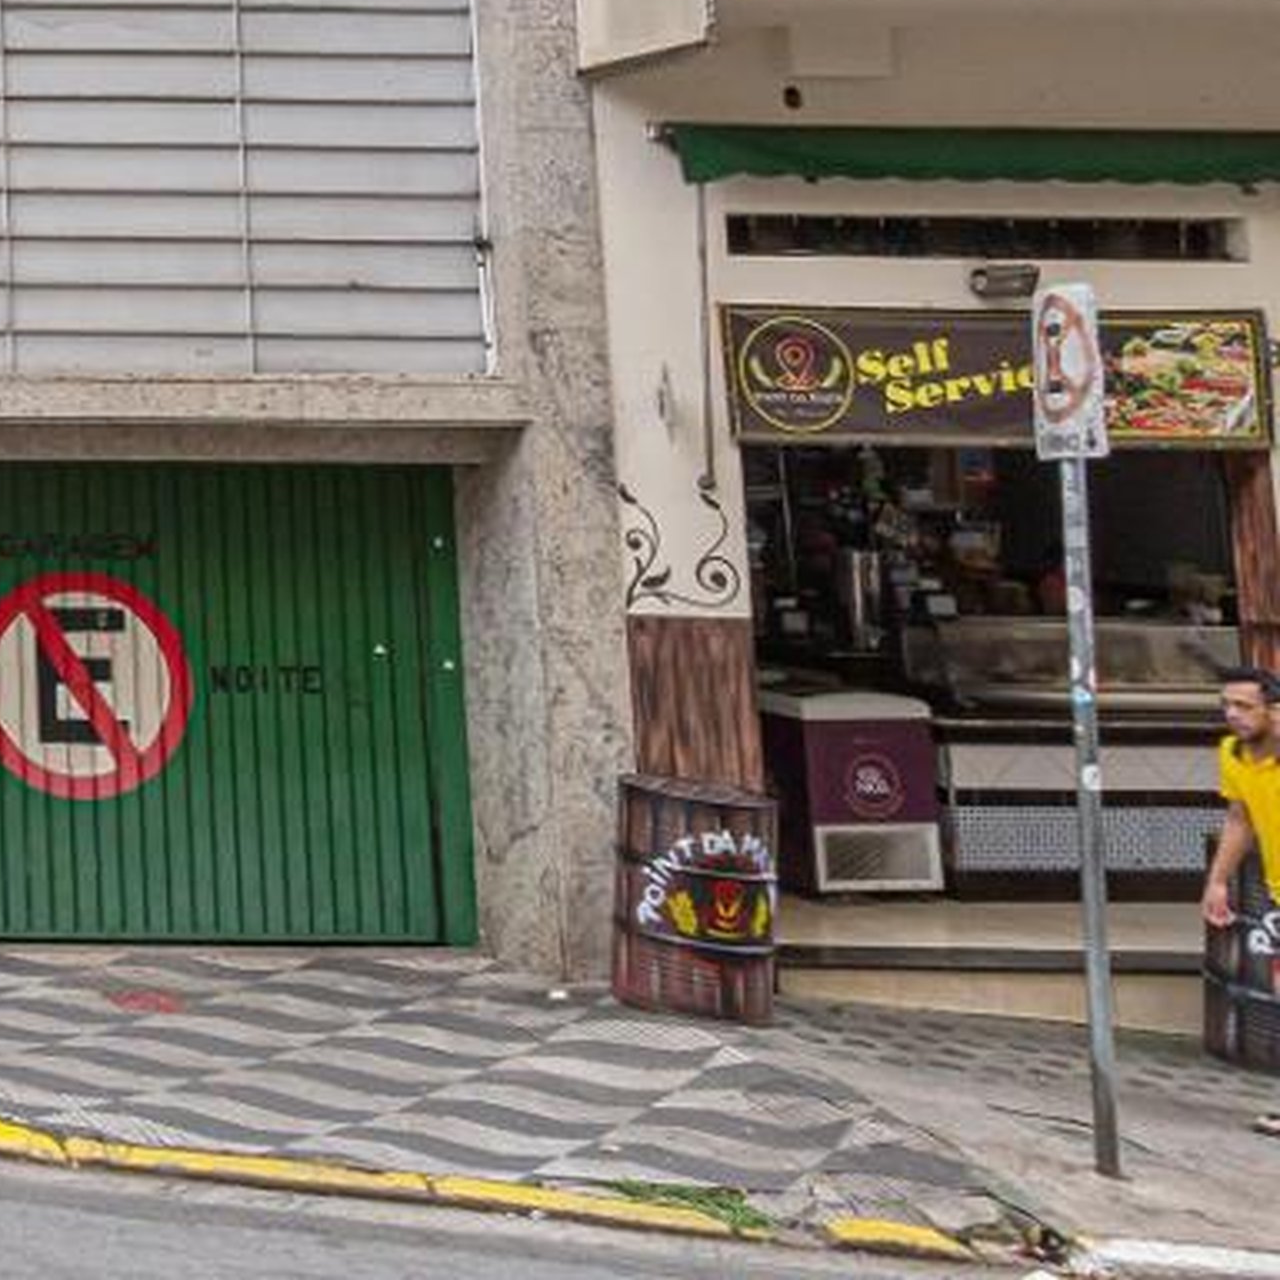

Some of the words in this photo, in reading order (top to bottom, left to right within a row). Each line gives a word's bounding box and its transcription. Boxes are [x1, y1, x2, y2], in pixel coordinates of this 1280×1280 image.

[856, 337, 950, 384] Self
[885, 360, 1034, 413] Servic
[210, 665, 324, 694] NOITE
